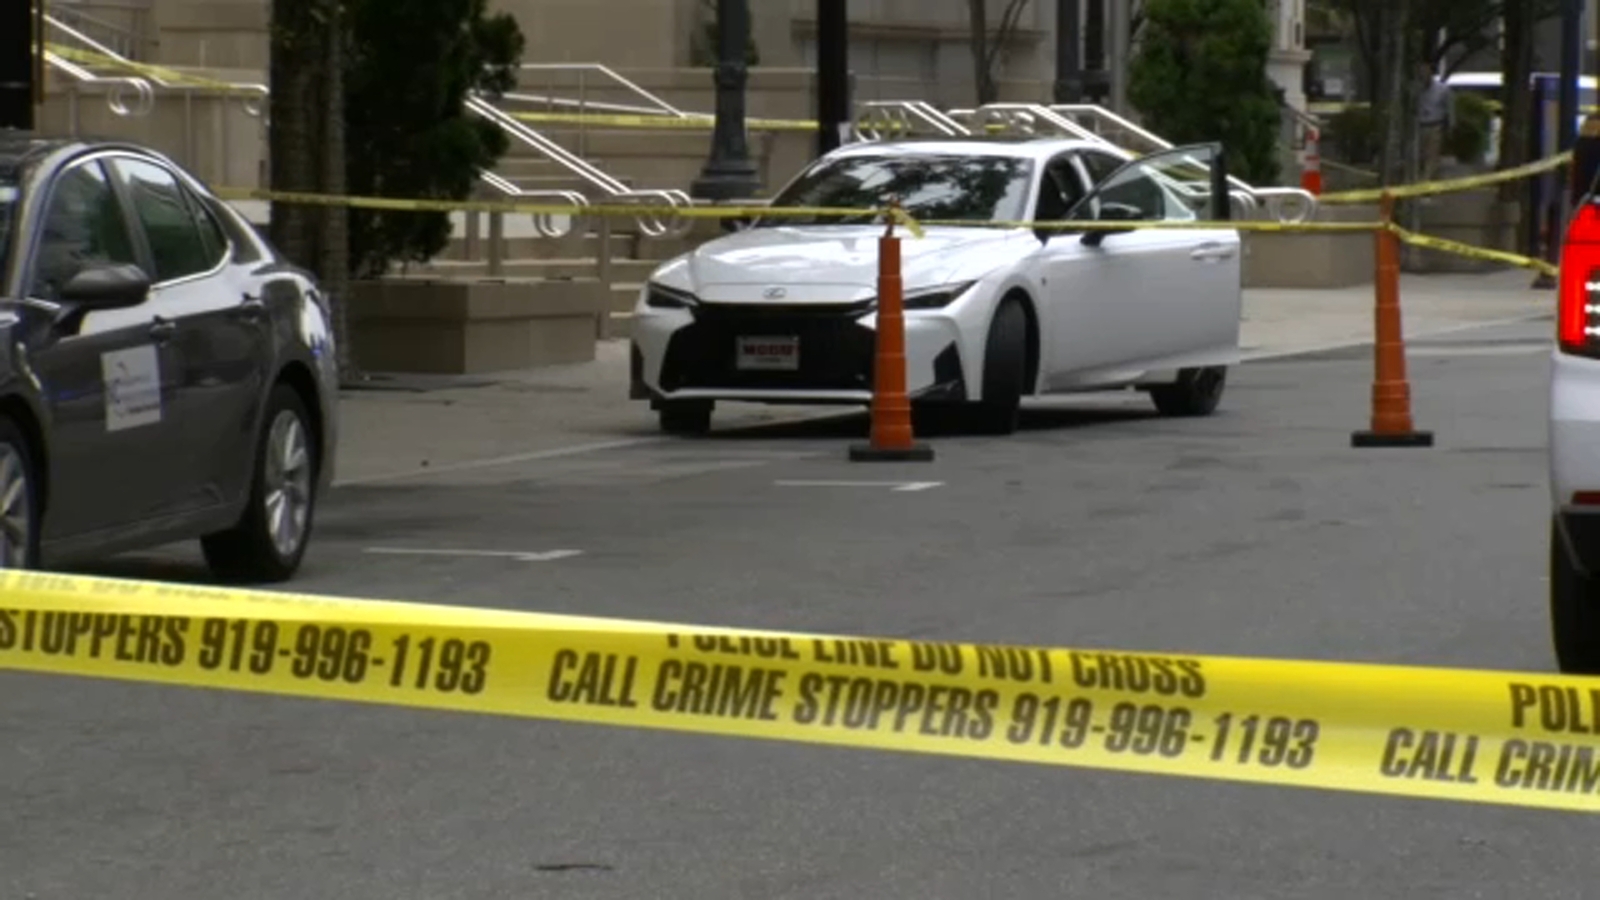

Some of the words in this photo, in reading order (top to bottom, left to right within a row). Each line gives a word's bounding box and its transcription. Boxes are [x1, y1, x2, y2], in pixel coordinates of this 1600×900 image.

[198, 616, 492, 694] 919-996-1193
[1068, 652, 1206, 698] CROSS
[546, 648, 638, 708] CALL
[651, 659, 787, 720] CRIME
[793, 672, 999, 740] STOPPERS
[1006, 693, 1319, 769] 919-996-1193
[1508, 682, 1600, 735] POLI
[1379, 727, 1480, 783] CALL
[1494, 738, 1600, 793] CRIM
